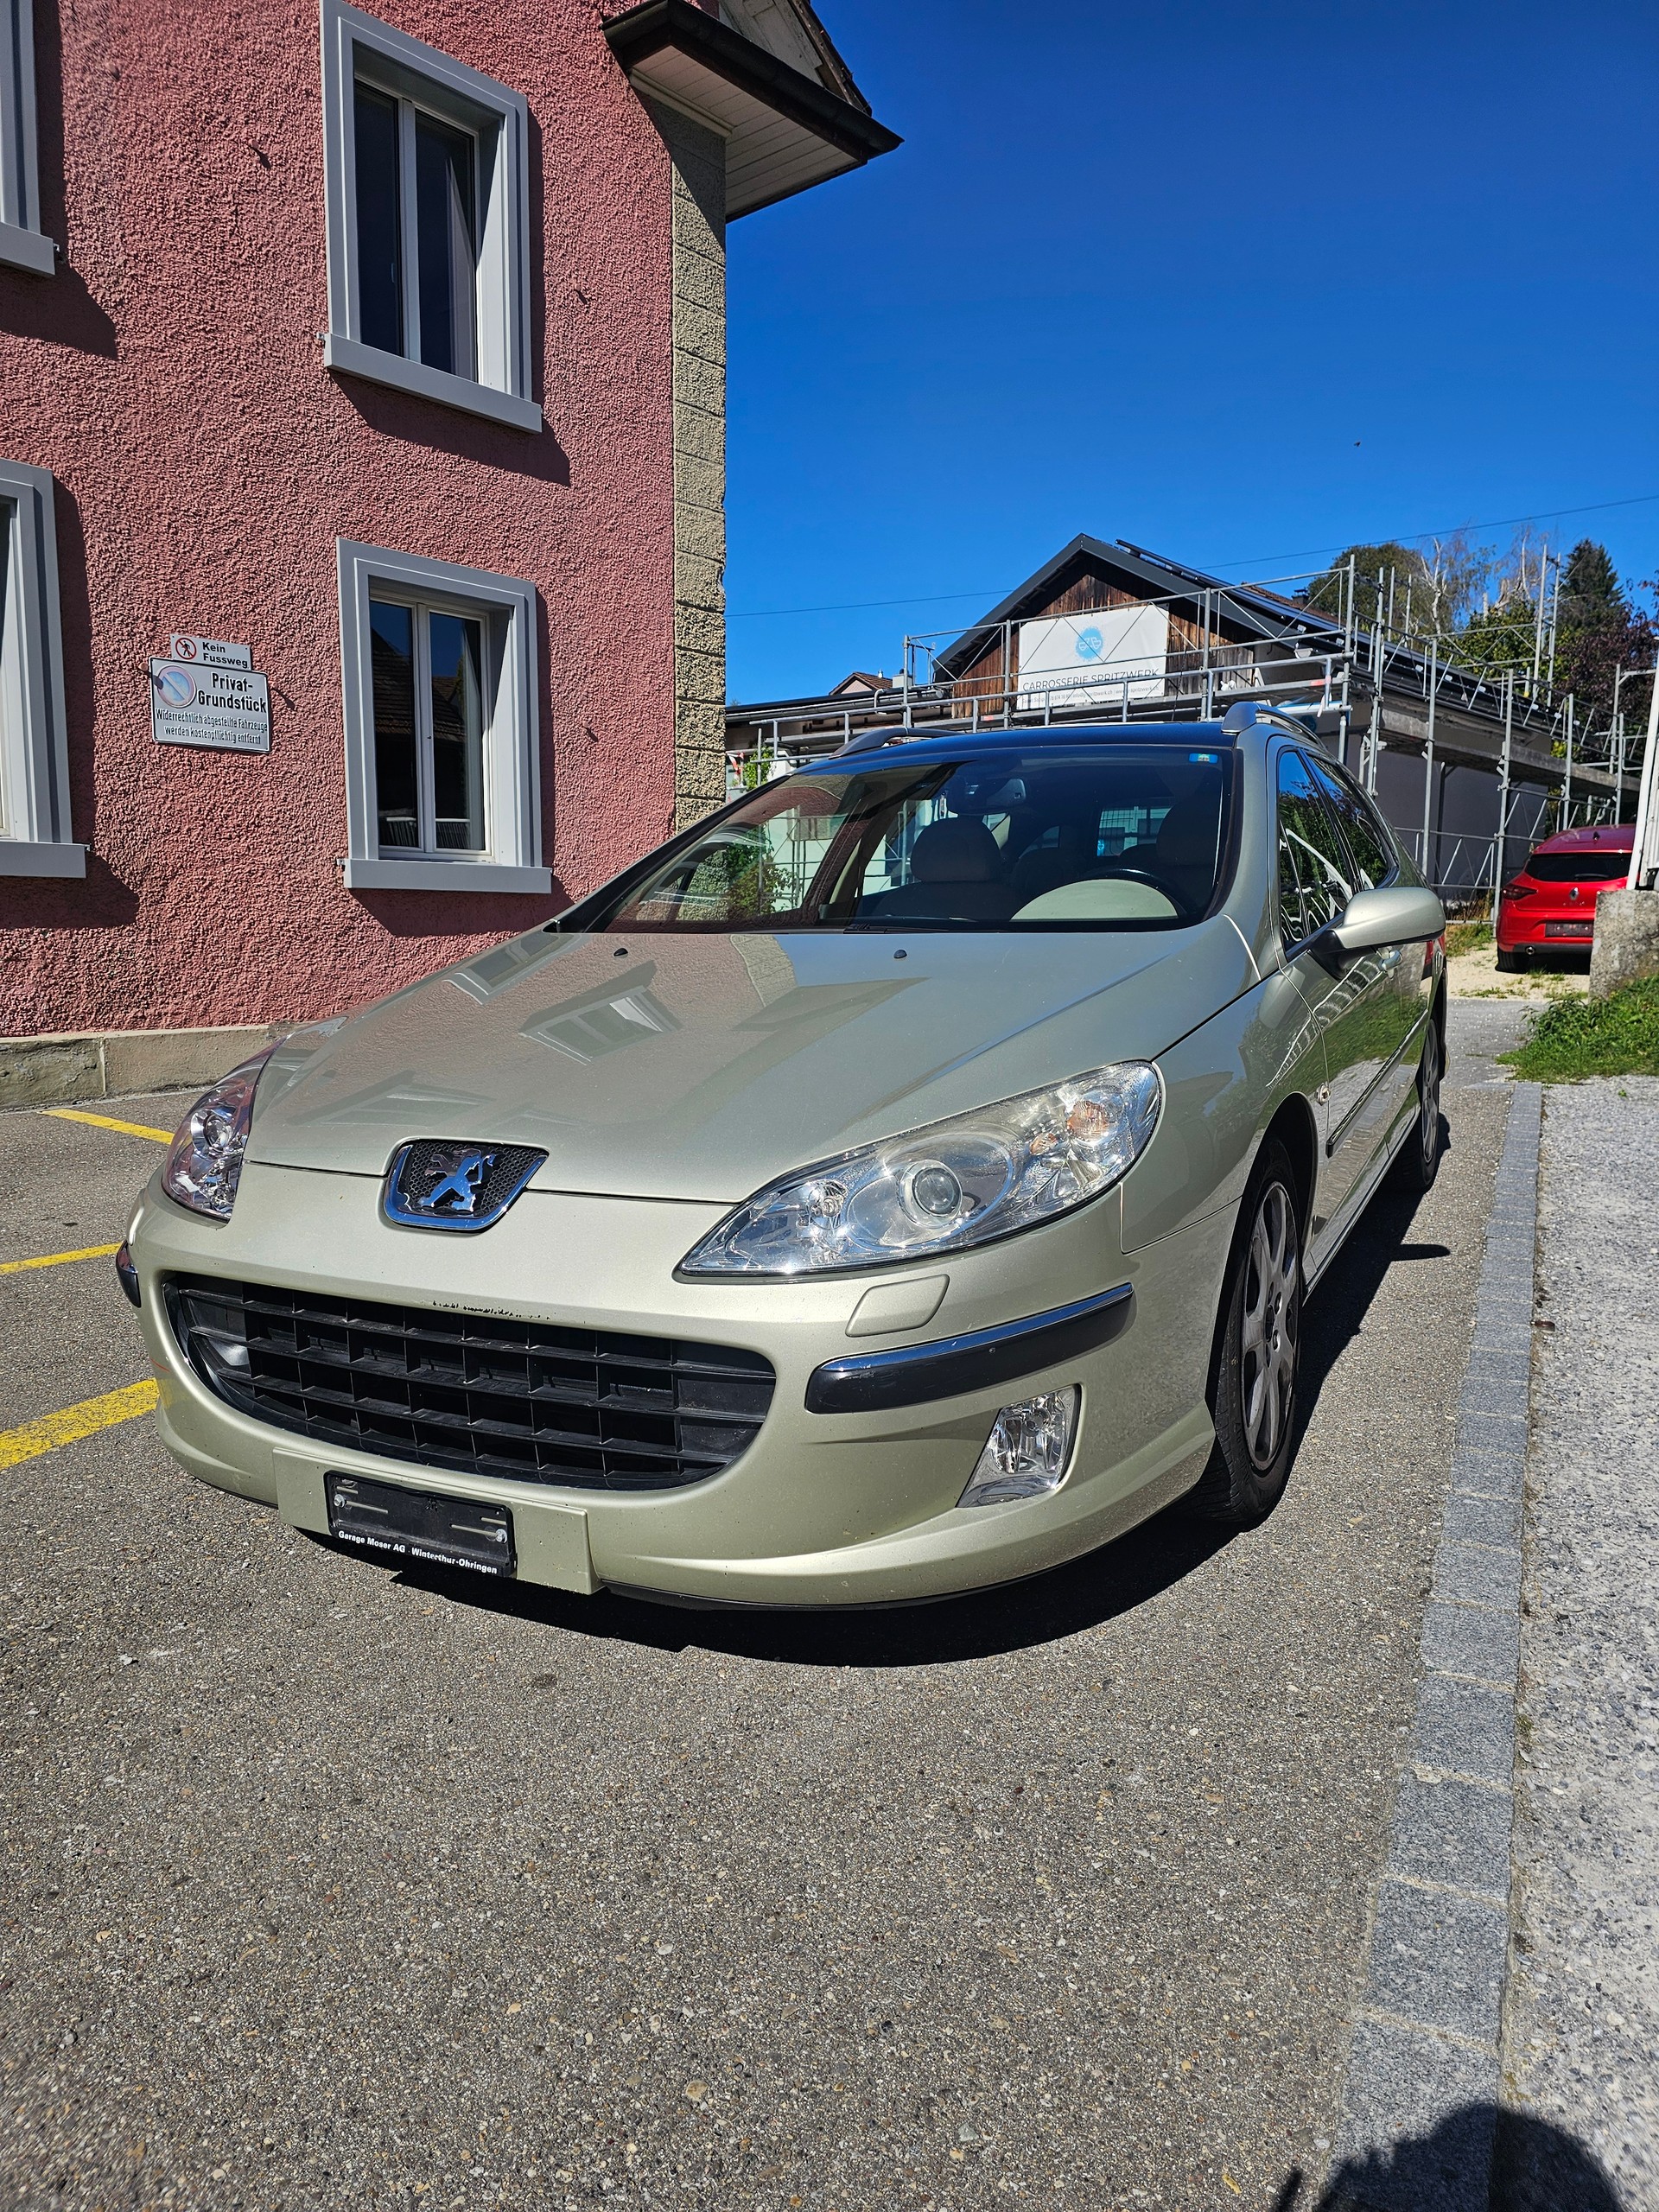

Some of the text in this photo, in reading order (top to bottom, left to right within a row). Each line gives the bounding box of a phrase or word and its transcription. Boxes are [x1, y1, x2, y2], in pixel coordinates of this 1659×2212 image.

[202, 641, 226, 653] Kein
[203, 652, 248, 669] Fussweg
[211, 672, 253, 692] Privat-
[1022, 675, 1089, 692] CARROSSERIE
[1090, 668, 1160, 683] SPRITZWERK
[197, 690, 267, 713] Grundstück
[156, 709, 268, 732] Widerrechtlich abgestellte Fahrzeuge
[164, 726, 261, 745] werden kostenpflichtig entfernt
[338, 1530, 365, 1544] Garage
[366, 1537, 391, 1550] Moser
[392, 1543, 406, 1553] AG
